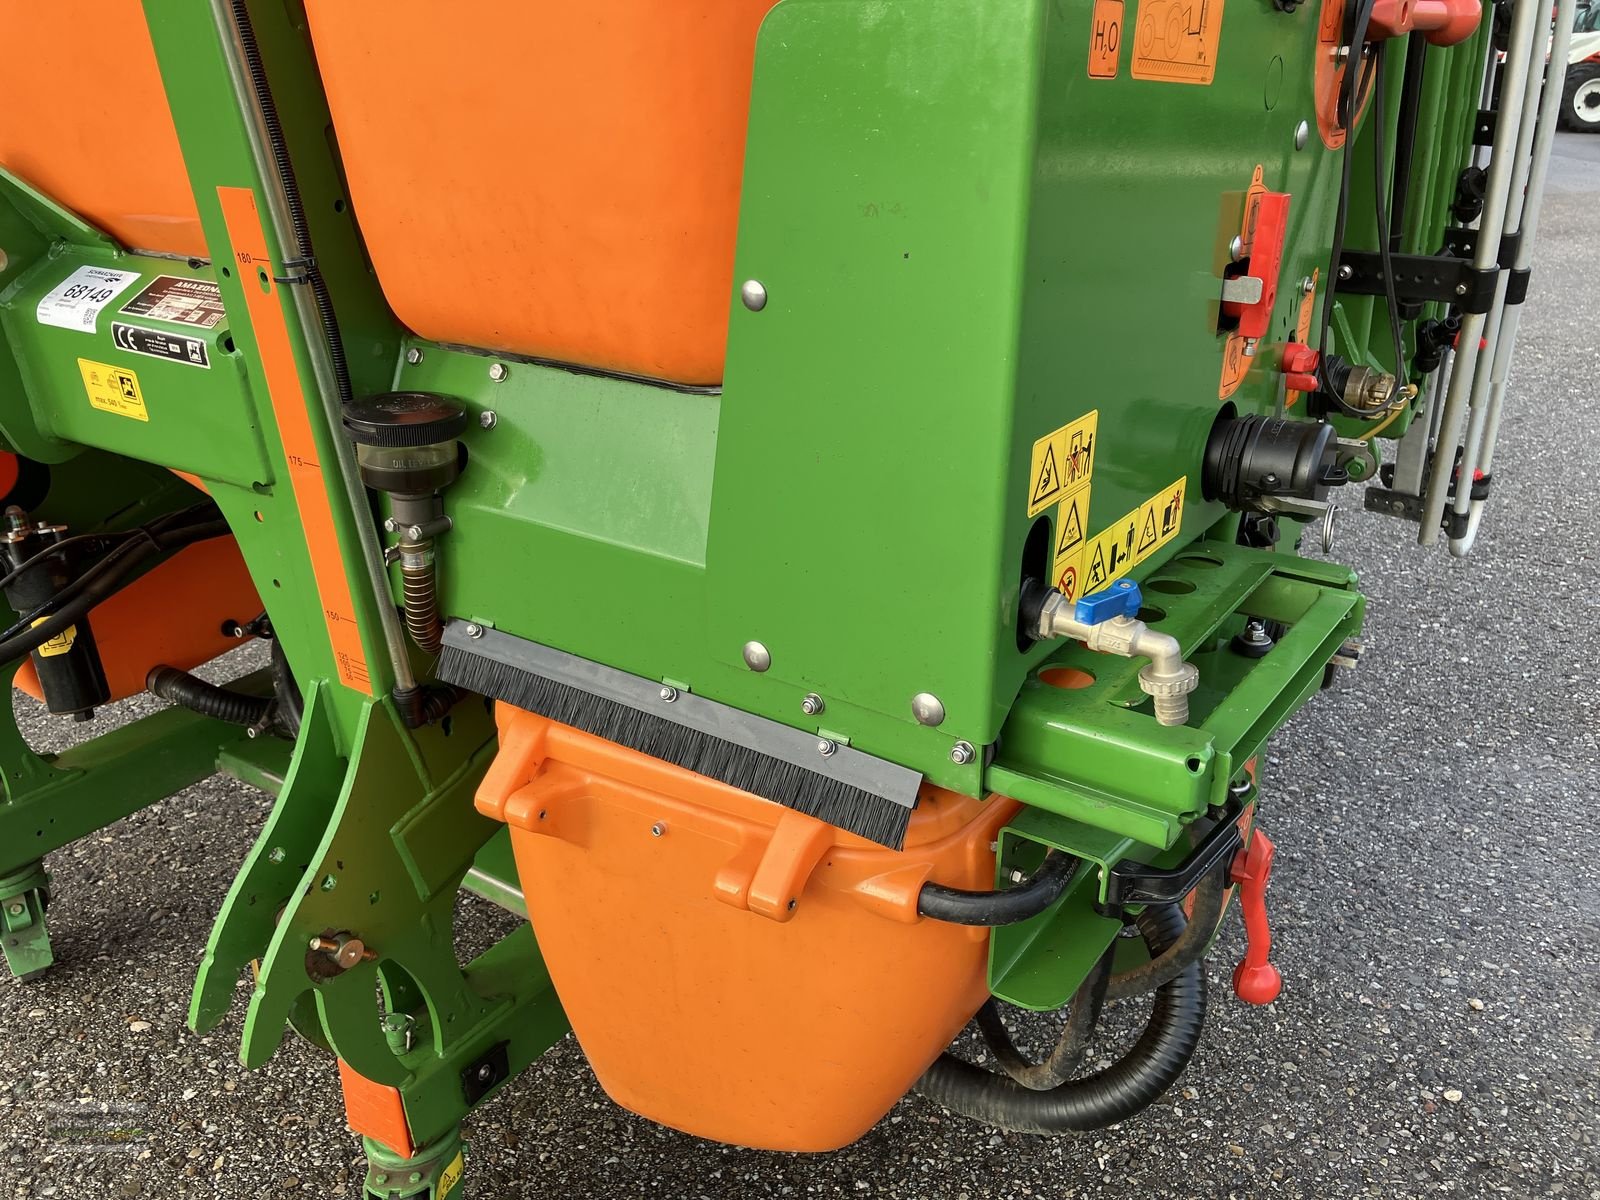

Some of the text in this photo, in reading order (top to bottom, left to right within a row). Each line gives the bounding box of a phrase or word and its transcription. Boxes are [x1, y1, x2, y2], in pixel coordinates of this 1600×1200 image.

[236, 252, 252, 264] 180
[63, 284, 113, 303] 68149
[117, 326, 138, 351] CE
[288, 455, 303, 467] 175
[392, 459, 407, 469] OIL
[325, 609, 340, 621] 150
